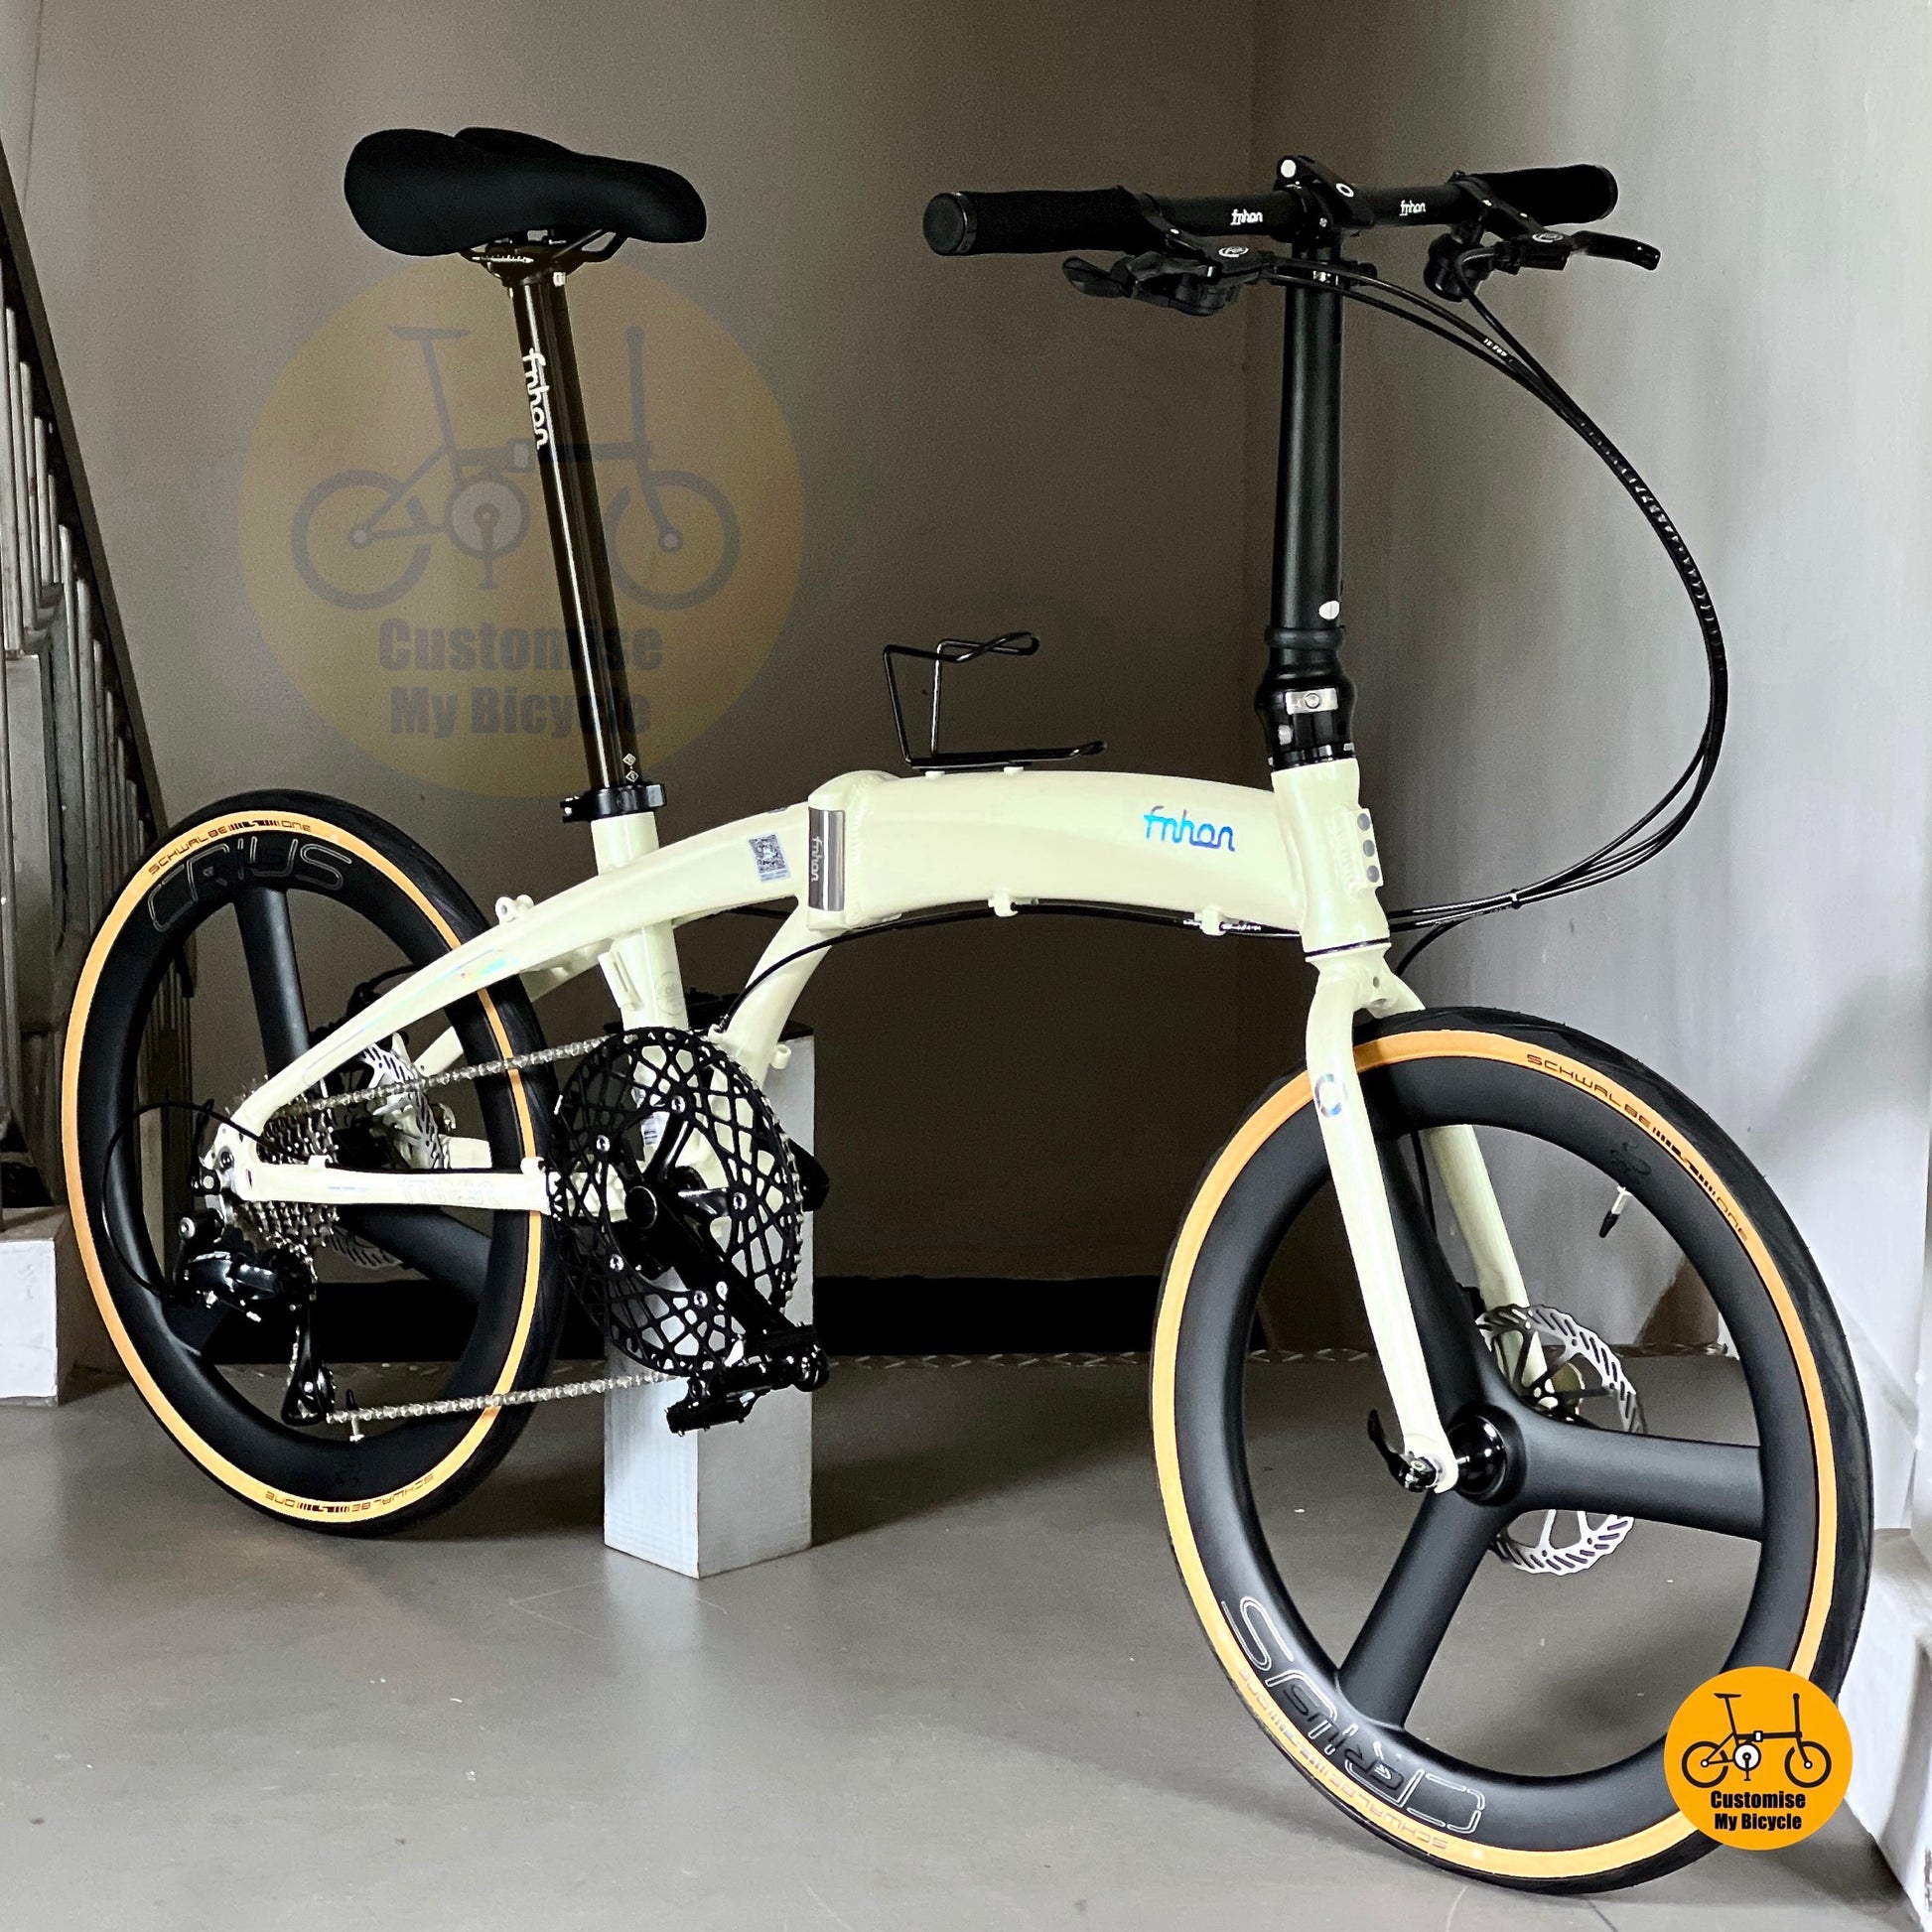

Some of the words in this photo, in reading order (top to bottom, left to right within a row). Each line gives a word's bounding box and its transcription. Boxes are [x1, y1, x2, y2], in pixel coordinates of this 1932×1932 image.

[148, 825, 227, 876] SCHWALBE
[281, 820, 311, 832] ONE
[1527, 1053, 1651, 1128] SCHWALBE
[1717, 1196, 1748, 1241] ONE
